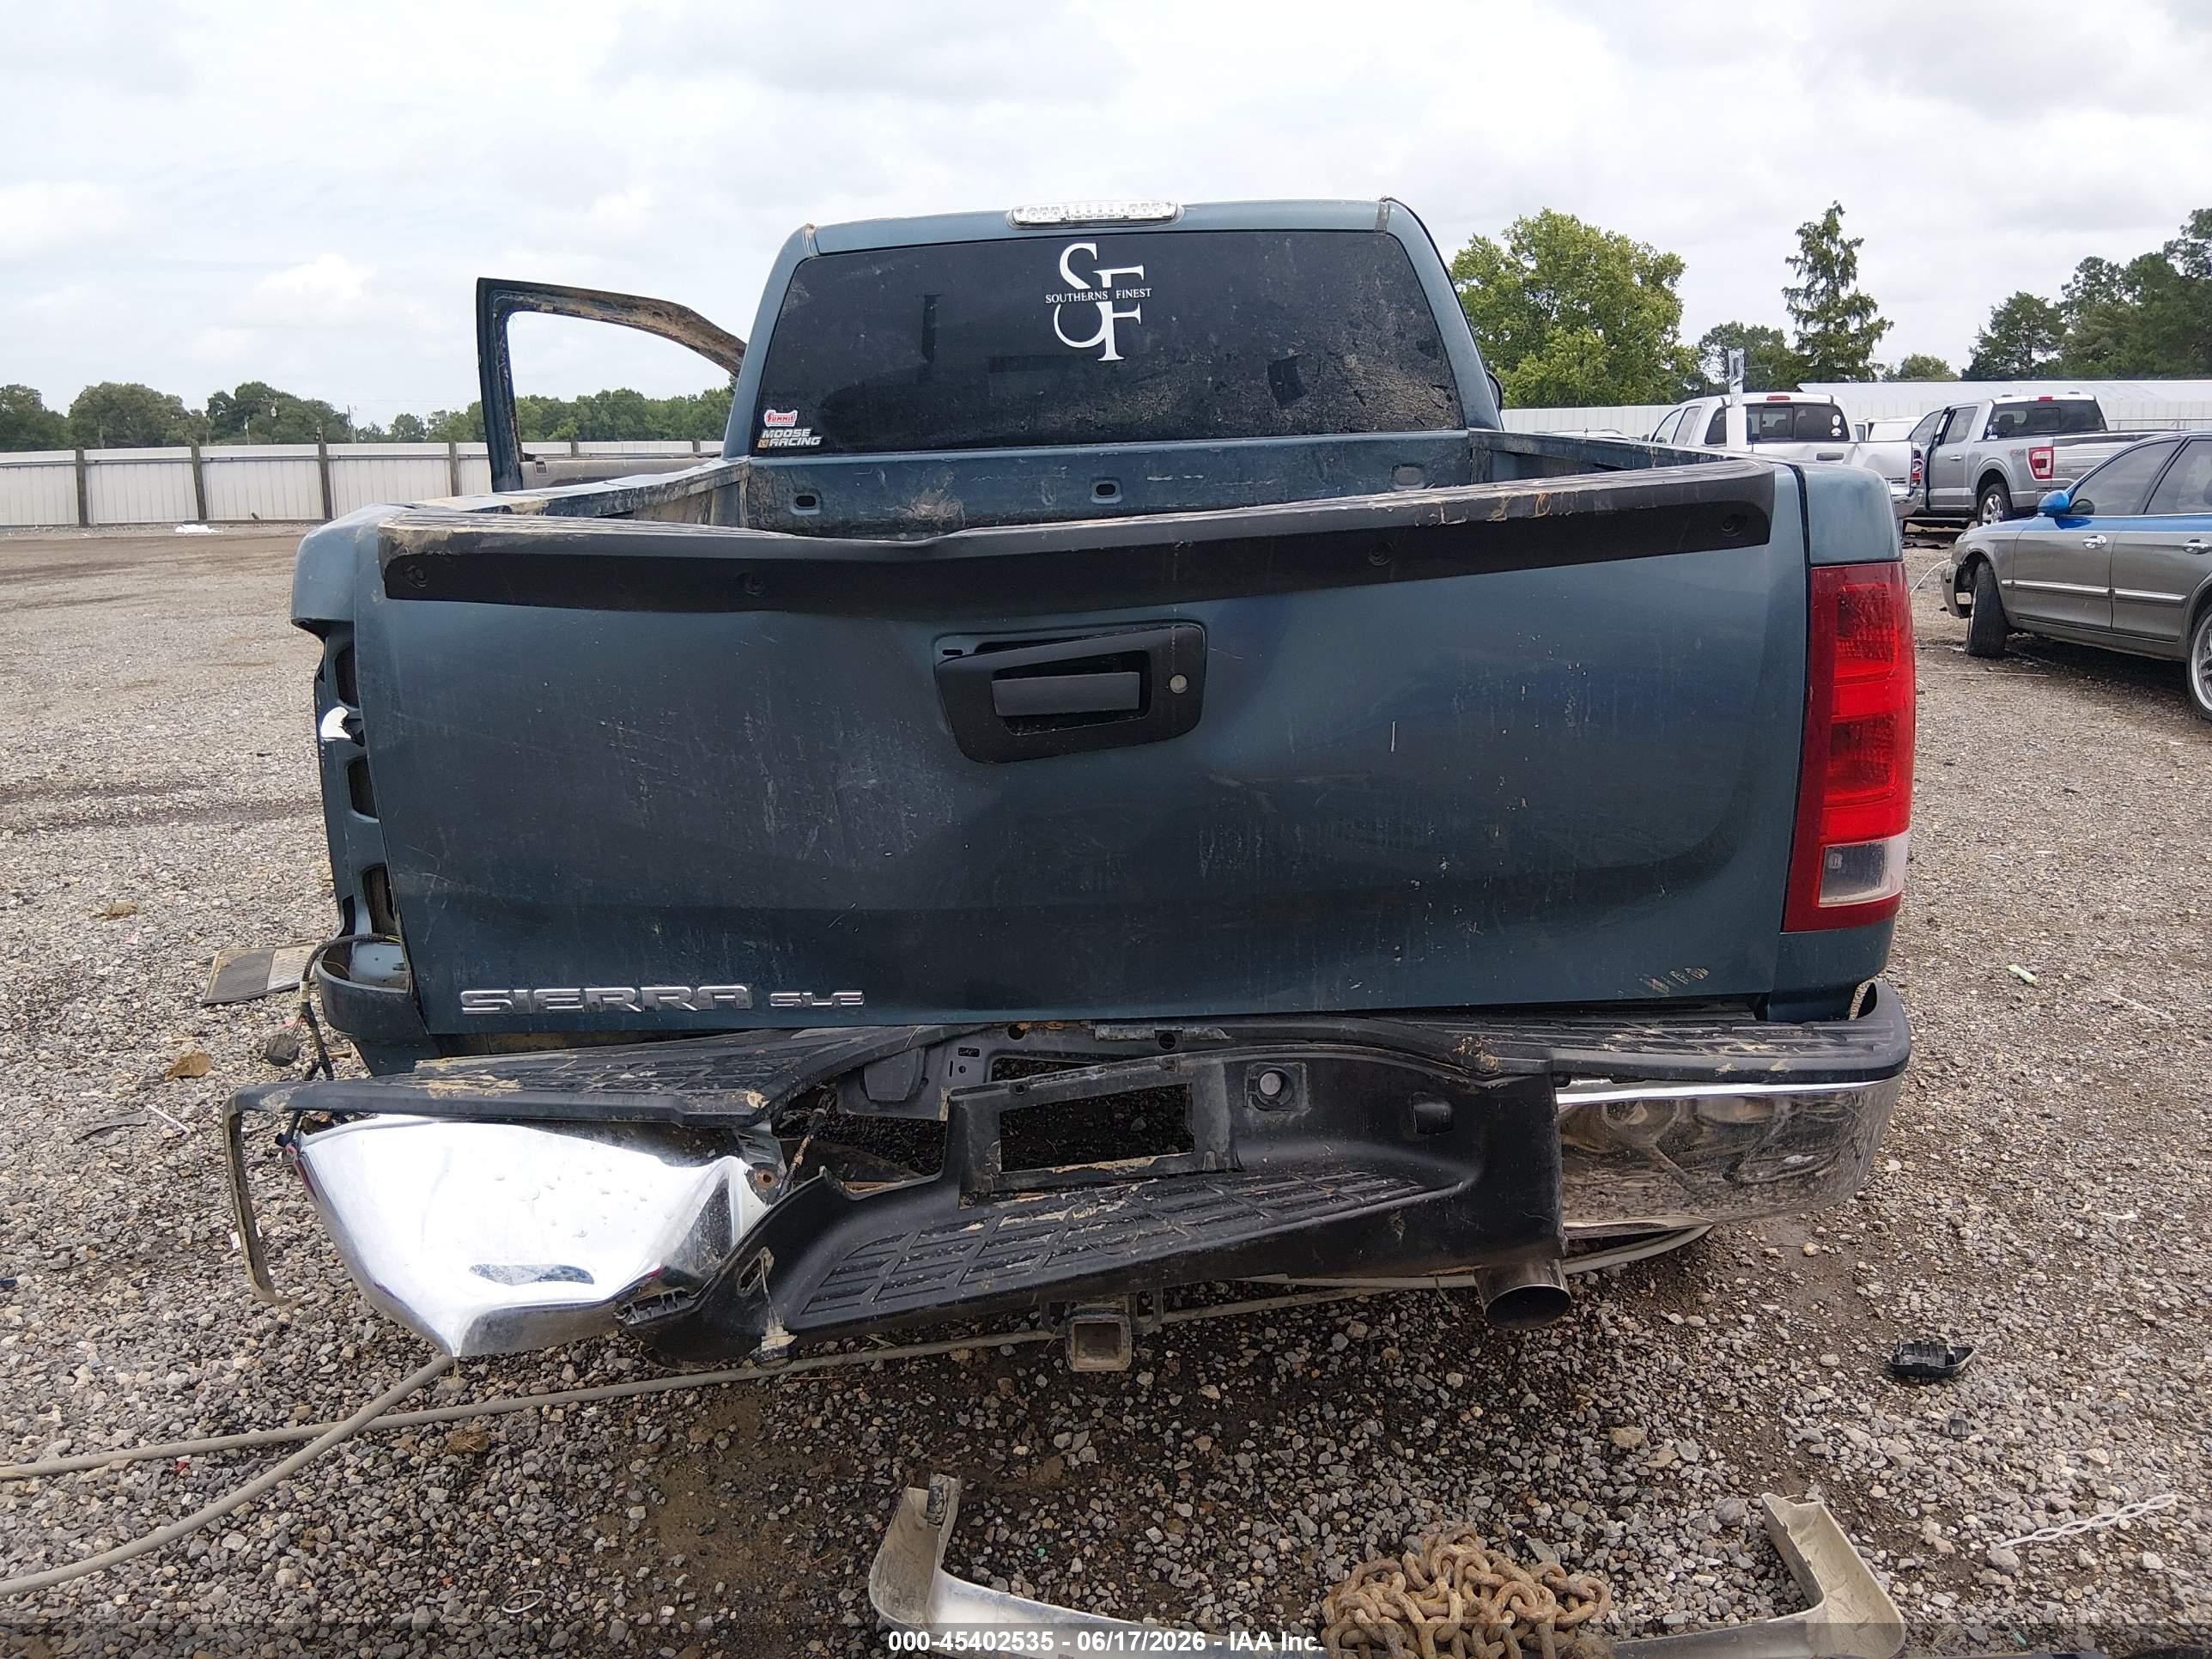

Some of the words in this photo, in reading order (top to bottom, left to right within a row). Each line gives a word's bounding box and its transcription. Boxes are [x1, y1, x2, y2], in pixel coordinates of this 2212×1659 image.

[1045, 290, 1109, 303] SOUTHERNS
[1115, 288, 1152, 299] FINEST
[762, 428, 811, 439] MOOSE
[769, 436, 822, 447] RACING
[460, 985, 752, 1015] SIERRA
[770, 989, 864, 1007] SLE
